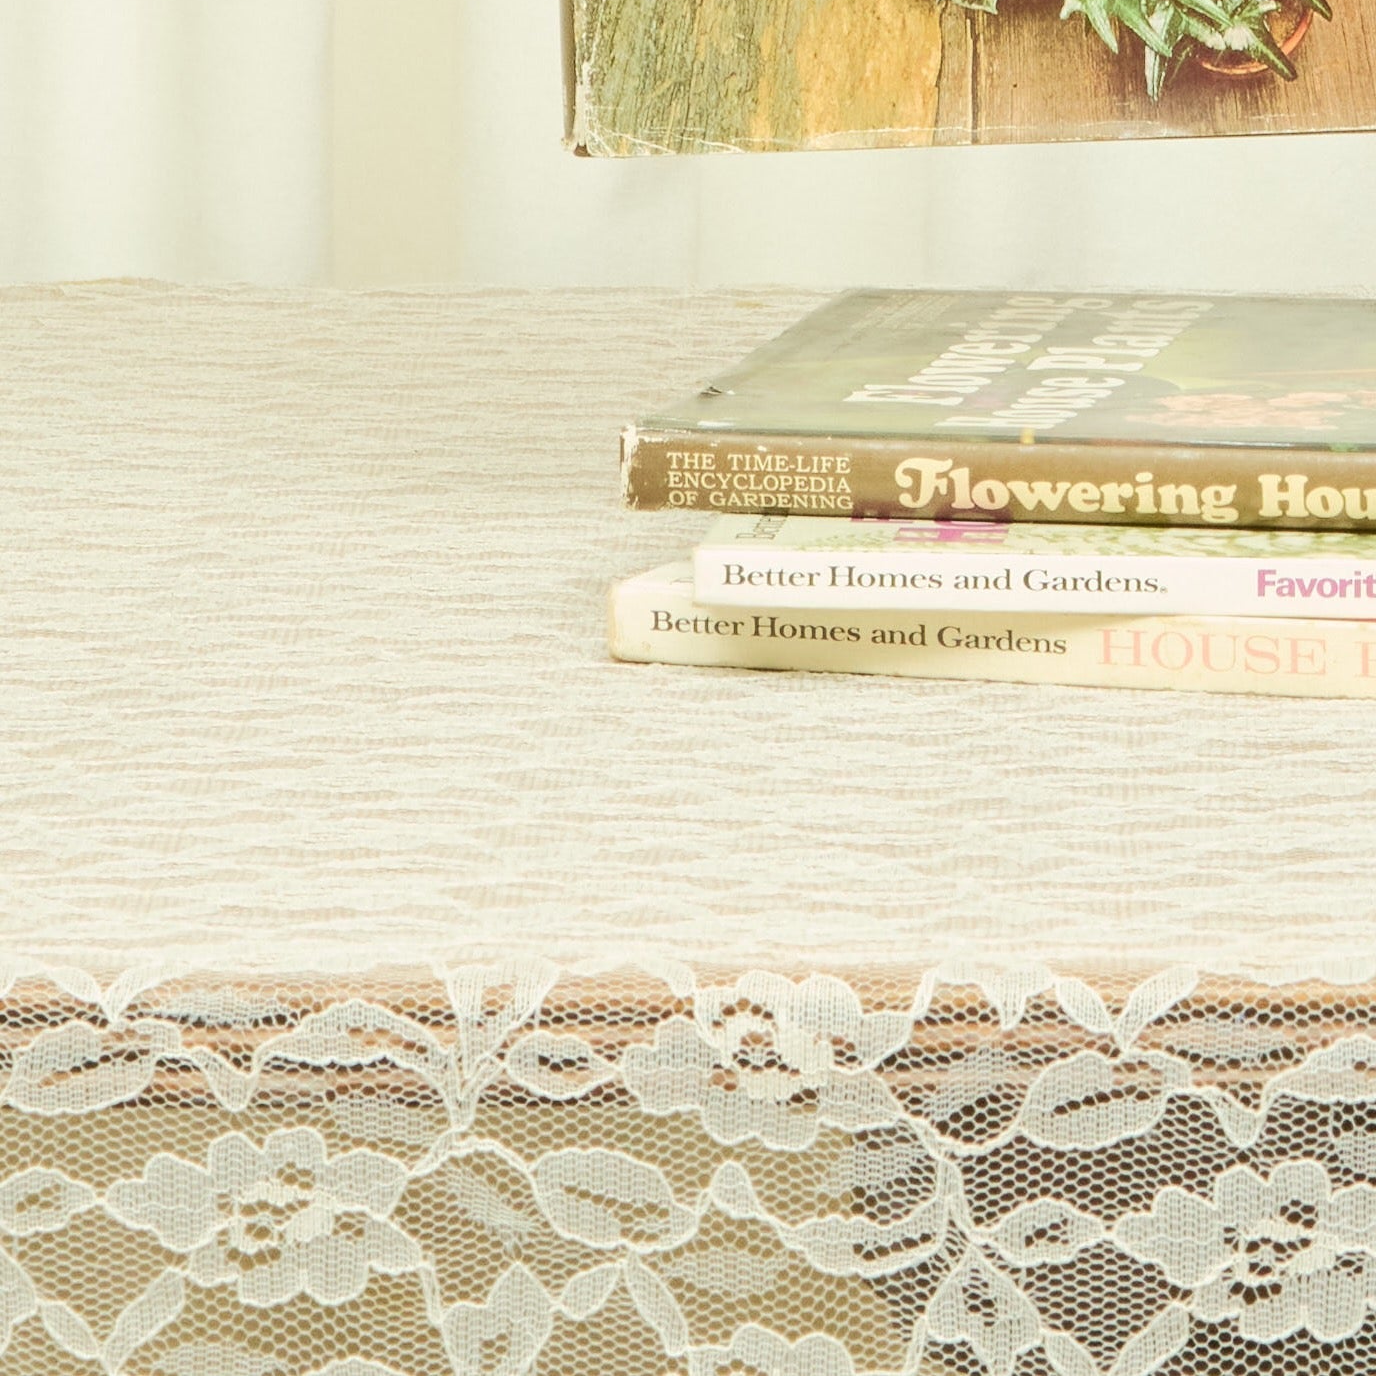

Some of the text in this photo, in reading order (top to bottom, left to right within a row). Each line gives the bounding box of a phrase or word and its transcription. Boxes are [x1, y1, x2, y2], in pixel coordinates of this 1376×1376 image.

[842, 295, 1114, 407] Flowering
[1026, 298, 1215, 373] Plants
[934, 375, 1126, 430] House
[665, 451, 852, 474] THE TIME-LIFE
[666, 471, 853, 494] ENCYCLOPEDIA
[894, 457, 1238, 522] Flowering
[668, 492, 854, 510] OF GARDENING
[722, 564, 823, 589] Better
[828, 565, 948, 591] Homes
[954, 566, 1015, 591] and
[650, 610, 745, 637] Better
[750, 615, 862, 643] Homes
[870, 624, 928, 647] and
[936, 626, 1068, 655] Gardens
[1100, 629, 1328, 677] HOUSE
